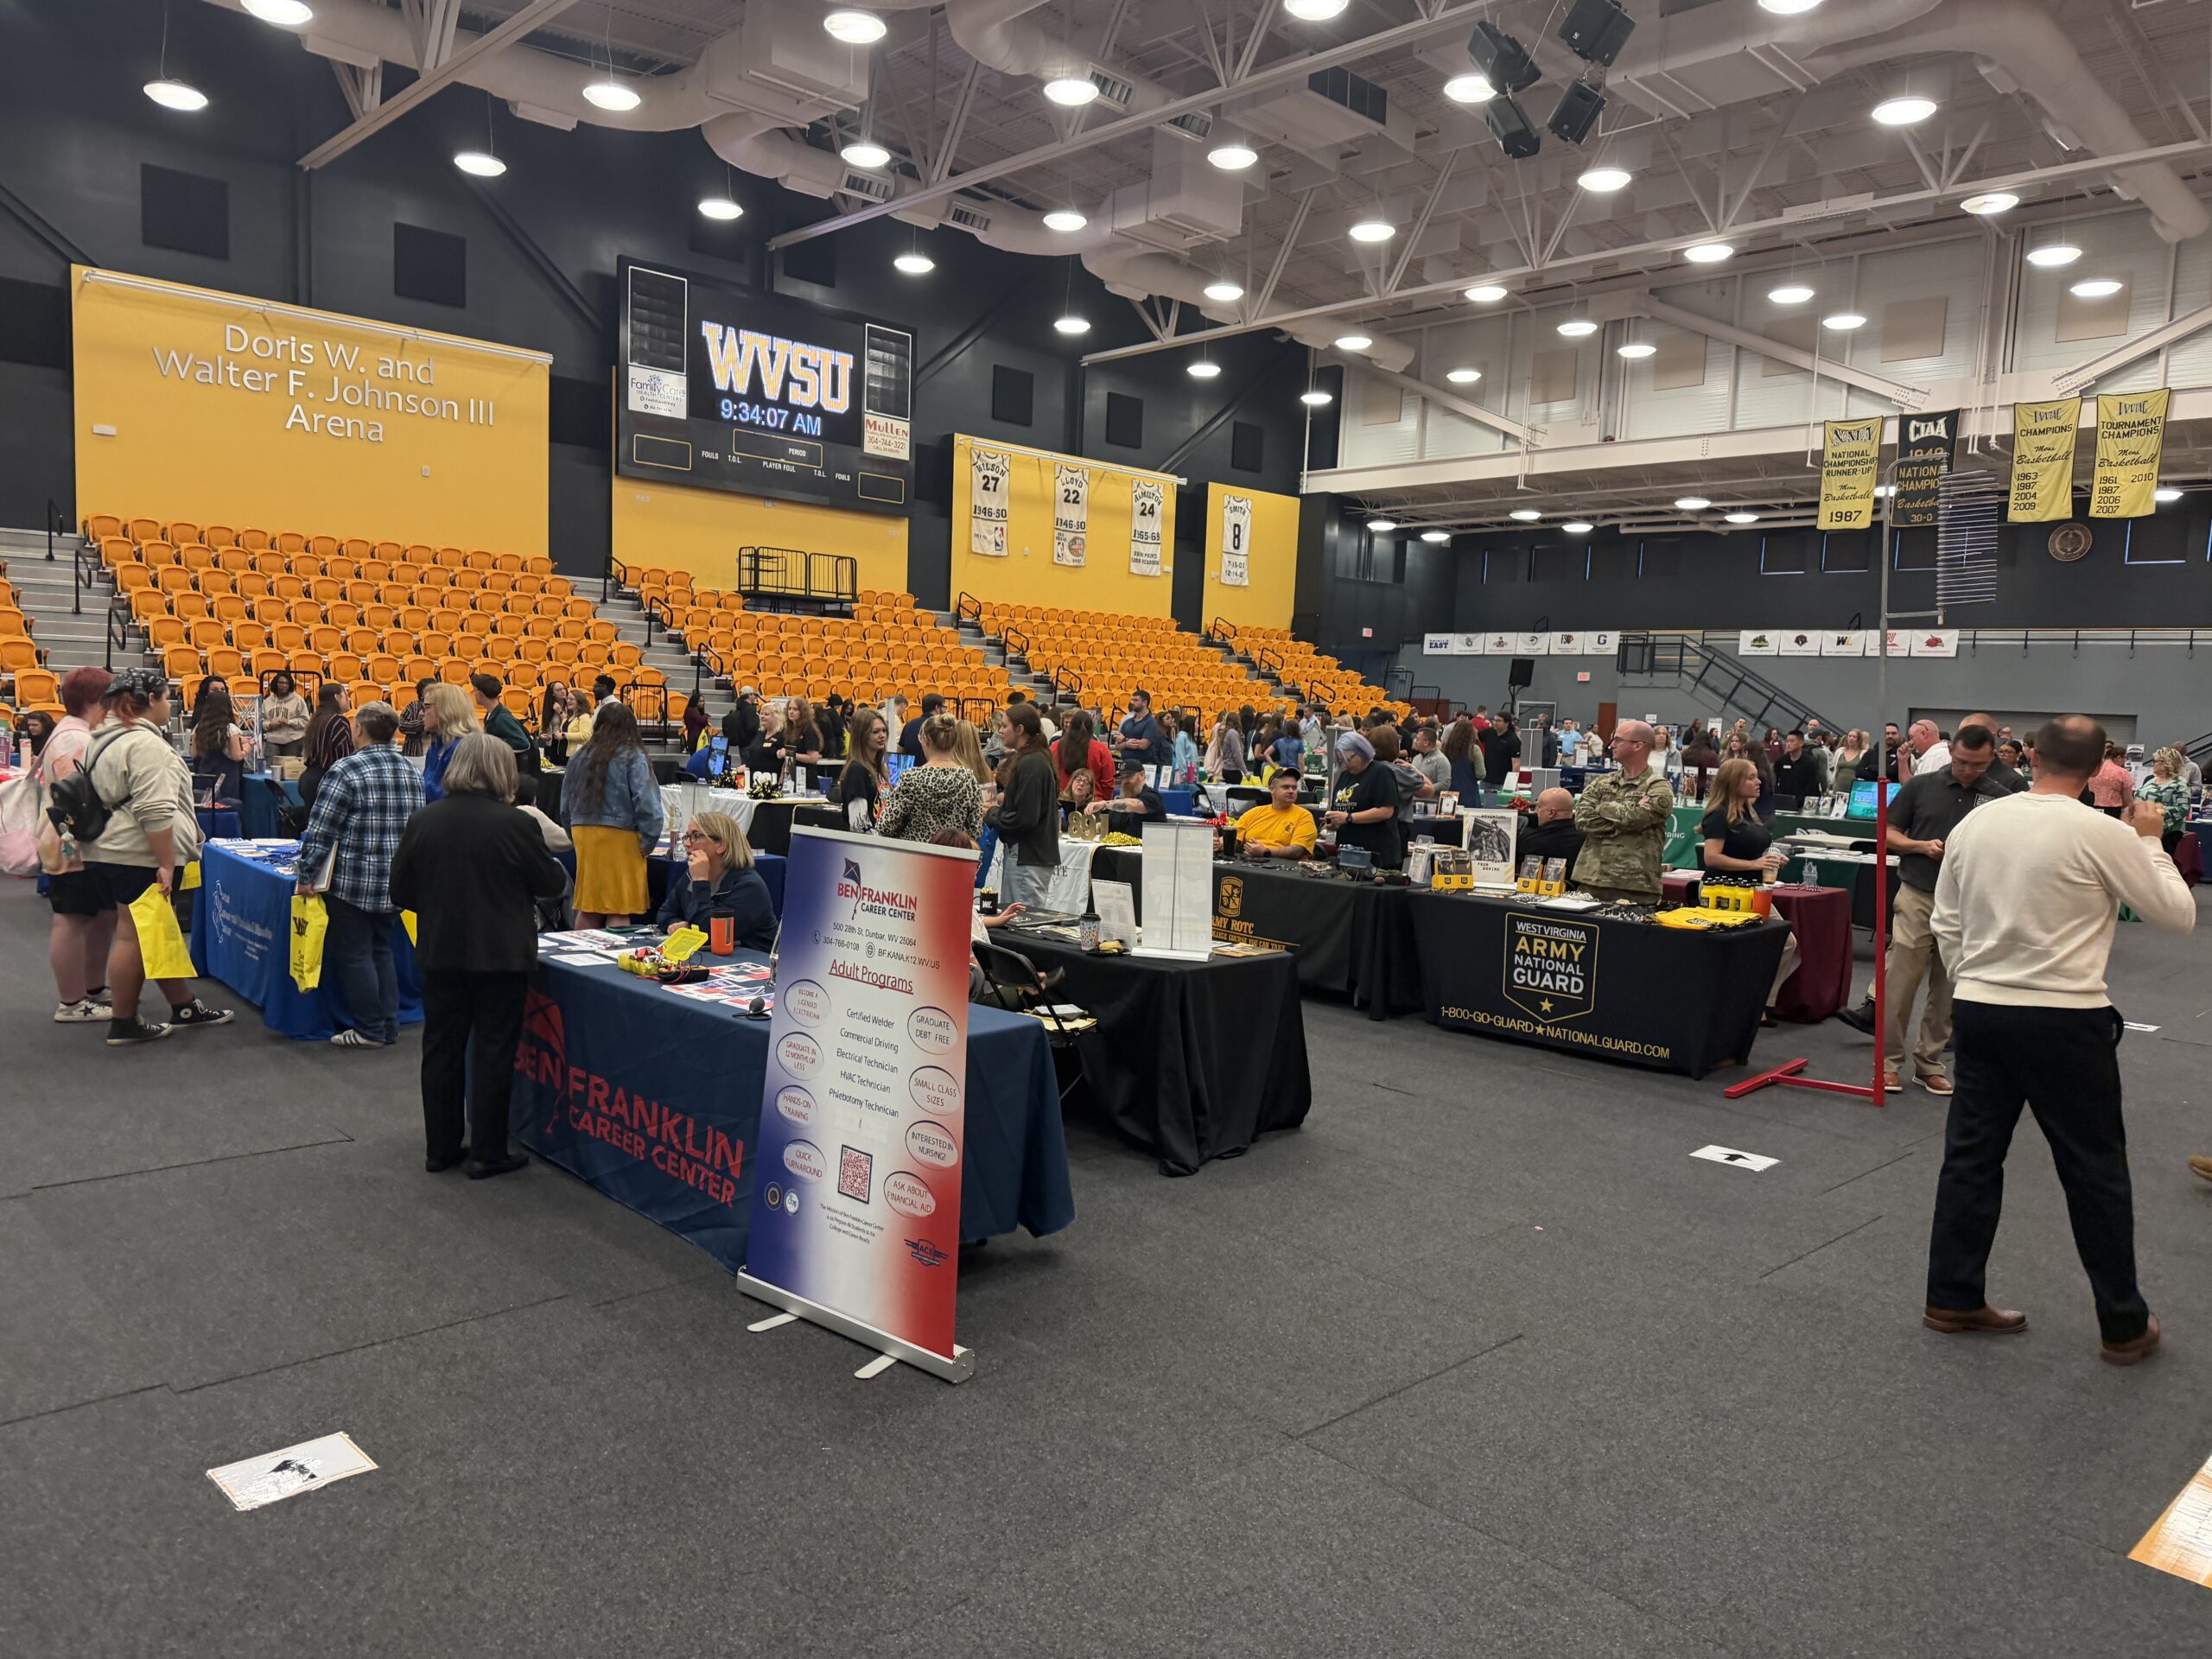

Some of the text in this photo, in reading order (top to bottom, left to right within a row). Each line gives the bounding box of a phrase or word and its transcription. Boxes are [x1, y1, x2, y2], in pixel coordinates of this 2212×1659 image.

[226, 324, 434, 385] Doris W. and
[702, 320, 854, 414] WVSU
[153, 346, 494, 426] Walter F. Johnson III
[631, 378, 685, 397] FamilyCare
[285, 404, 384, 442] Arena
[721, 398, 822, 436] 9:34:07 AM
[2101, 416, 2163, 430] TOURNAMENT
[1909, 416, 1948, 442] CIAA
[2019, 423, 2074, 437] CHAMPIONS
[2101, 425, 2160, 440] CHAMPIONS
[702, 450, 719, 460] FOULS
[788, 448, 807, 457] PERIOD
[1832, 449, 1871, 459] NATIONAL
[2016, 448, 2073, 465] Basketball
[2098, 452, 2158, 467] Basketball
[762, 461, 796, 473] PLAYER FOUL
[976, 462, 1006, 477] WILSON
[1823, 456, 1878, 468] CHAMPIONSHIP
[835, 473, 850, 481] FOULS
[1826, 466, 1872, 477] RUNNER-UP
[1899, 465, 1942, 478] NATIONA
[2017, 472, 2038, 481] 1963
[2130, 473, 2154, 483] 2010
[982, 474, 1000, 493] 27
[1060, 476, 1084, 489] LLOYD
[1897, 479, 1941, 492] CHAMPIO
[2017, 481, 2037, 491] 1987
[2099, 475, 2118, 485] 1961
[1064, 488, 1080, 505] 22
[1134, 490, 1163, 506] HAMILTON
[1824, 490, 1873, 502] Basketball
[2014, 492, 2037, 501] 2004
[2098, 486, 2120, 494] 1987
[1897, 497, 1942, 510] Basketba
[2013, 502, 2036, 511] 2009
[2097, 495, 2121, 505] 2006
[973, 505, 1007, 518] 1946-50
[1139, 502, 1155, 518] 24
[1230, 505, 1247, 517] SMITH
[1829, 511, 1862, 523] 1987
[2095, 505, 2120, 514] 2007
[1055, 517, 1086, 531] 1946-50
[1910, 513, 1933, 523] 30-0
[1133, 529, 1160, 541] 1965-69
[1232, 523, 1242, 550] 8
[1597, 634, 1607, 645] G
[1836, 636, 1853, 646] WL
[837, 882, 918, 911] BEN FRANKLIN
[861, 903, 915, 922] CAREER CENTER
[1212, 915, 1254, 934] RMY ROTC
[1516, 921, 1586, 940] WEST VIRGINIA
[833, 922, 843, 931] 500
[844, 925, 856, 934] 28th
[865, 929, 887, 942] Dunbar,
[887, 934, 899, 944] WV
[899, 936, 916, 947] 25064
[823, 936, 940, 969] 304-766-0108 BF.KANA.K12.WV.US
[1516, 936, 1586, 963] ARMY
[1514, 954, 1584, 976] NATIONAL
[830, 958, 913, 992] Adult Programs
[1513, 967, 1584, 994] GUARD
[846, 1007, 894, 1029] Certified Welder
[916, 1014, 950, 1031] GRADUATE
[840, 1027, 899, 1054] Commercial Driving
[916, 1028, 950, 1045] DEBT FREE
[1440, 1006, 1669, 1059] 1-800-GO-GUARD NATIONALGUARD.COM
[786, 1040, 817, 1056] GRADUATE IN
[791, 1052, 809, 1064] MONTHS
[836, 1047, 898, 1074] Electrical Technician
[794, 1062, 805, 1071] LESS
[840, 1070, 891, 1093] HVAC Technician
[914, 1077, 957, 1097] SMALL CLASS
[783, 1093, 811, 1109] HANDS-ON
[829, 1088, 899, 1119] Phlebotomy Technician
[926, 1094, 944, 1107] SIZES
[569, 1065, 744, 1179] FRANKLIN
[785, 1106, 809, 1122] TRAINING
[912, 1131, 954, 1152] INTERESTED IN
[569, 1105, 735, 1208] CAREER CENTER
[796, 1149, 812, 1162] QUICK
[785, 1157, 823, 1178] TURNAROUND
[893, 1180, 927, 1198] ASK ABOUT
[887, 1191, 931, 1213] FINANCIAL AID
